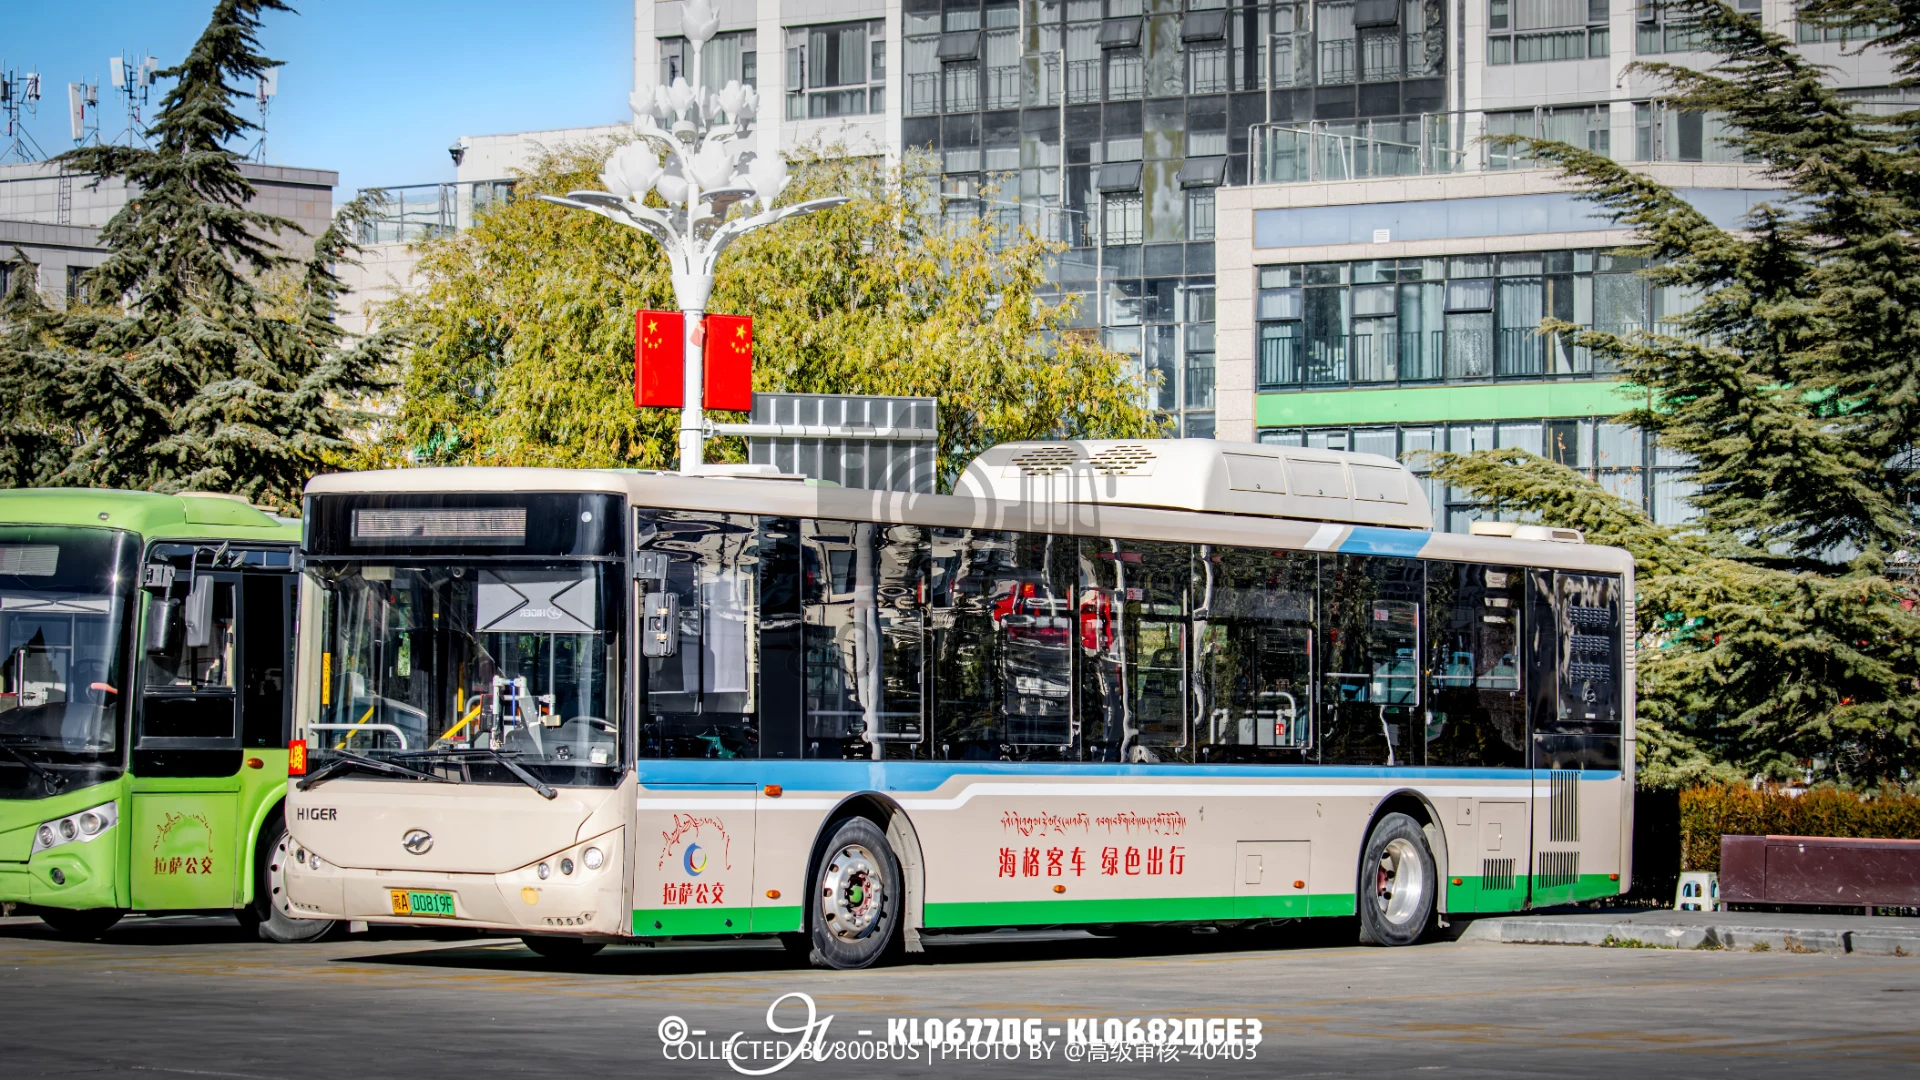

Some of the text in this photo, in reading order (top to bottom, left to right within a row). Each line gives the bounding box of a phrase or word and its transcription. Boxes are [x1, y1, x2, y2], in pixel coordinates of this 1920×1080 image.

[297, 808, 337, 821] HIGER
[153, 856, 213, 875] 拉萨公交
[998, 845, 1186, 878] 海格客车 绿色出行
[663, 882, 725, 905] 拉萨公交
